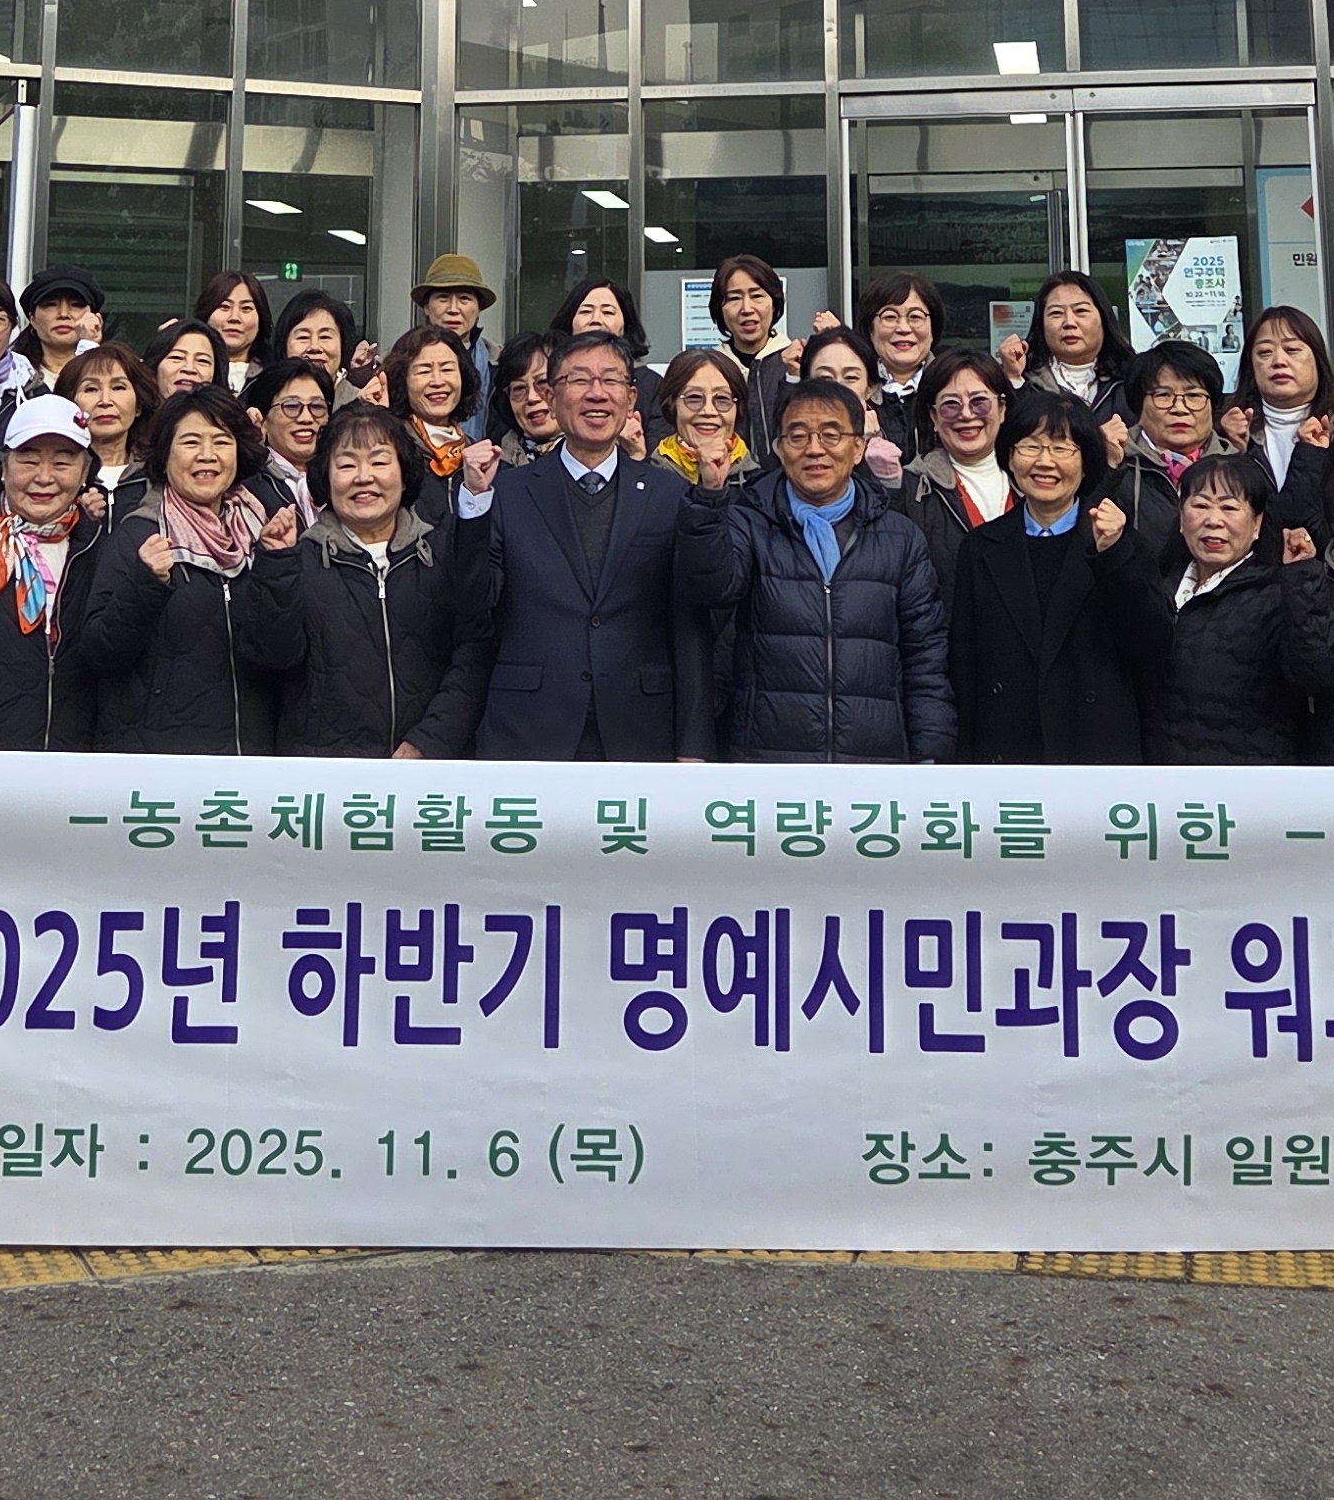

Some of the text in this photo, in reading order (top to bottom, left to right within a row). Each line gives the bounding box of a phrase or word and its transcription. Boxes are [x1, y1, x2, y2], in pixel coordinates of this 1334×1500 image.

[1183, 267, 1225, 278] 인구주택
[1192, 256, 1224, 266] 2025
[1194, 278, 1225, 289] 총조사
[597, 798, 648, 855] 및
[704, 799, 1052, 859] 역량강화를
[1105, 803, 1235, 860] 위한
[282, 902, 561, 1049] 하반기
[610, 906, 1191, 1061] 명예시민과장
[139, 1134, 150, 1170] :
[185, 1128, 342, 1178] 2025.
[378, 1131, 457, 1179] 11.
[489, 1130, 520, 1177] 6
[549, 1125, 645, 1183] (목)
[862, 1131, 1330, 1186] 장소: 충주시 일원
